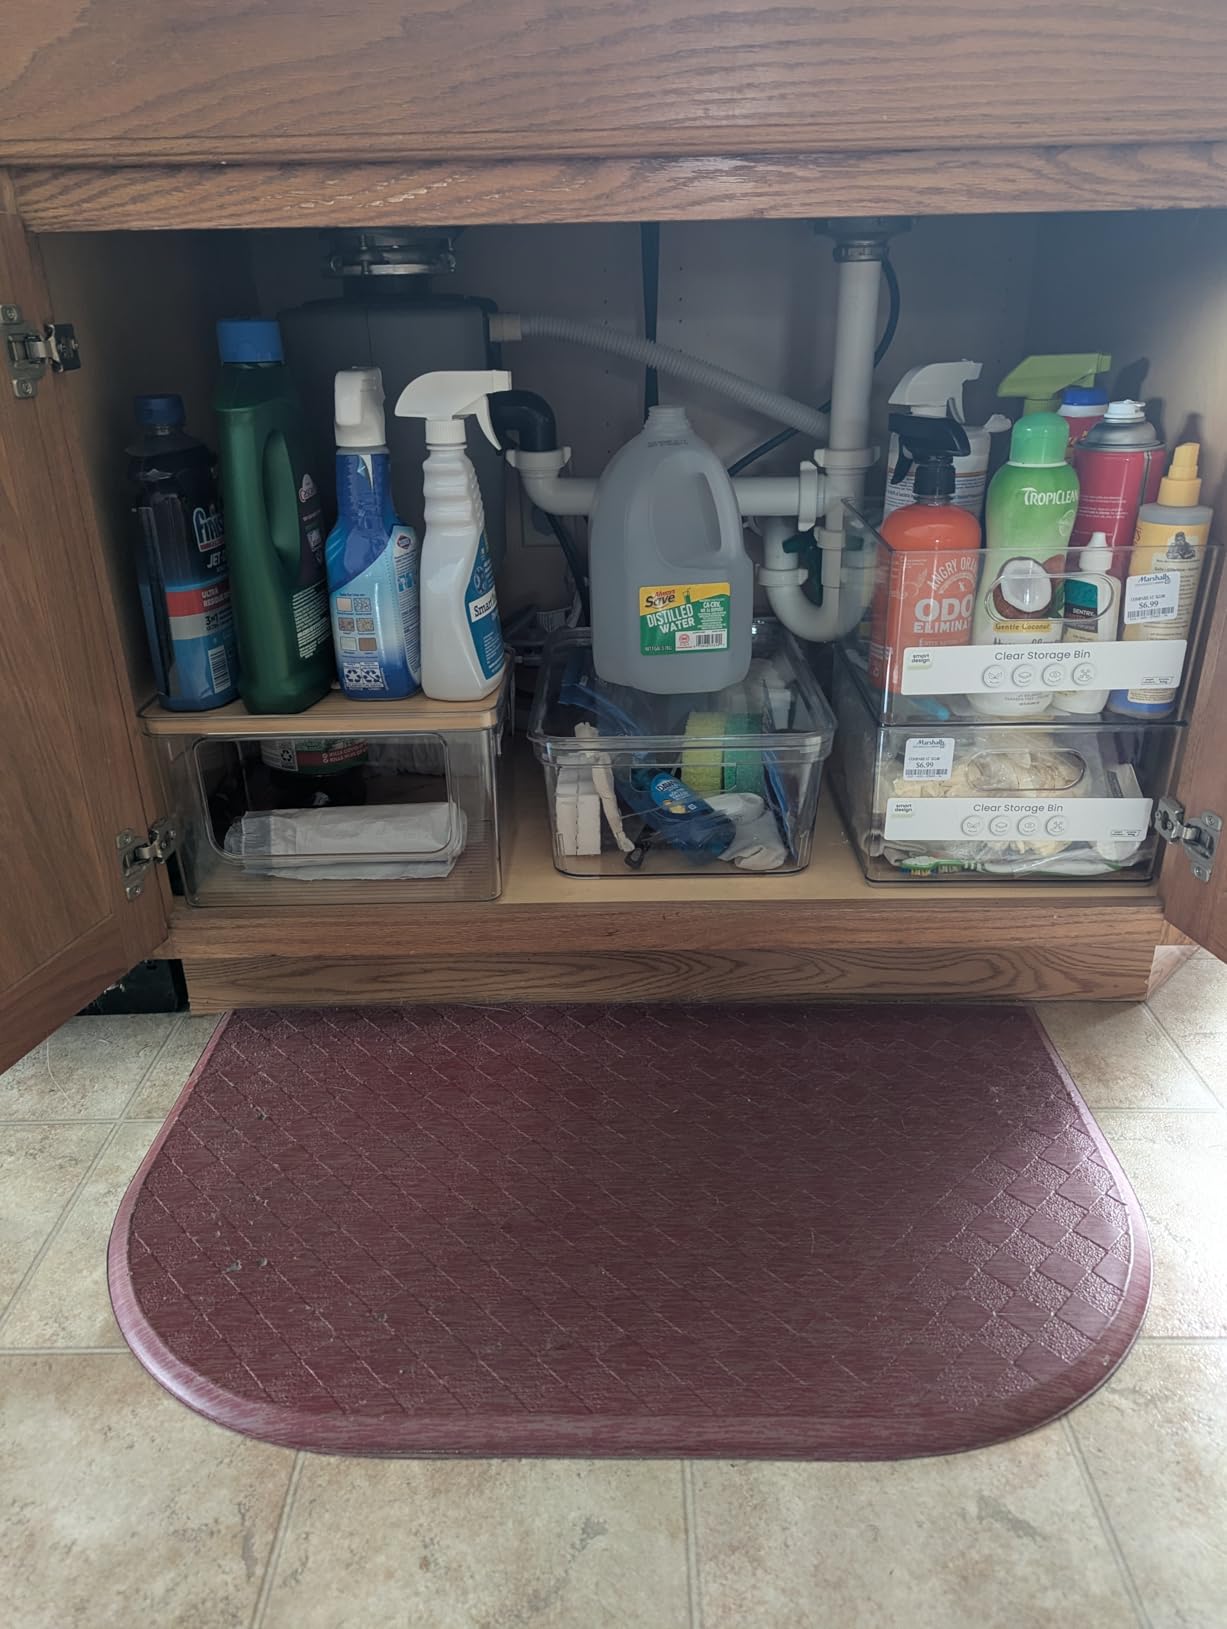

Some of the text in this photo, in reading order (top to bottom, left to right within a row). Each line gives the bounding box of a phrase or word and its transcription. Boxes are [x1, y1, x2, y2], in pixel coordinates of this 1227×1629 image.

[927, 556, 978, 590] ANGRY ORA
[1138, 573, 1171, 585] Marshalls
[645, 594, 676, 609] Save
[914, 594, 974, 622] ODO
[1138, 600, 1159, 609] $6.99
[646, 604, 694, 628] DISTILLED
[1072, 608, 1095, 617] SENTRY
[659, 617, 696, 634] WATER
[913, 617, 972, 634] ELIMINAT
[994, 649, 1091, 662] Clear Storage Bin
[916, 739, 945, 749] Marshalls
[915, 761, 934, 769] $6.99
[973, 803, 1064, 815] Clear Storage Bin
